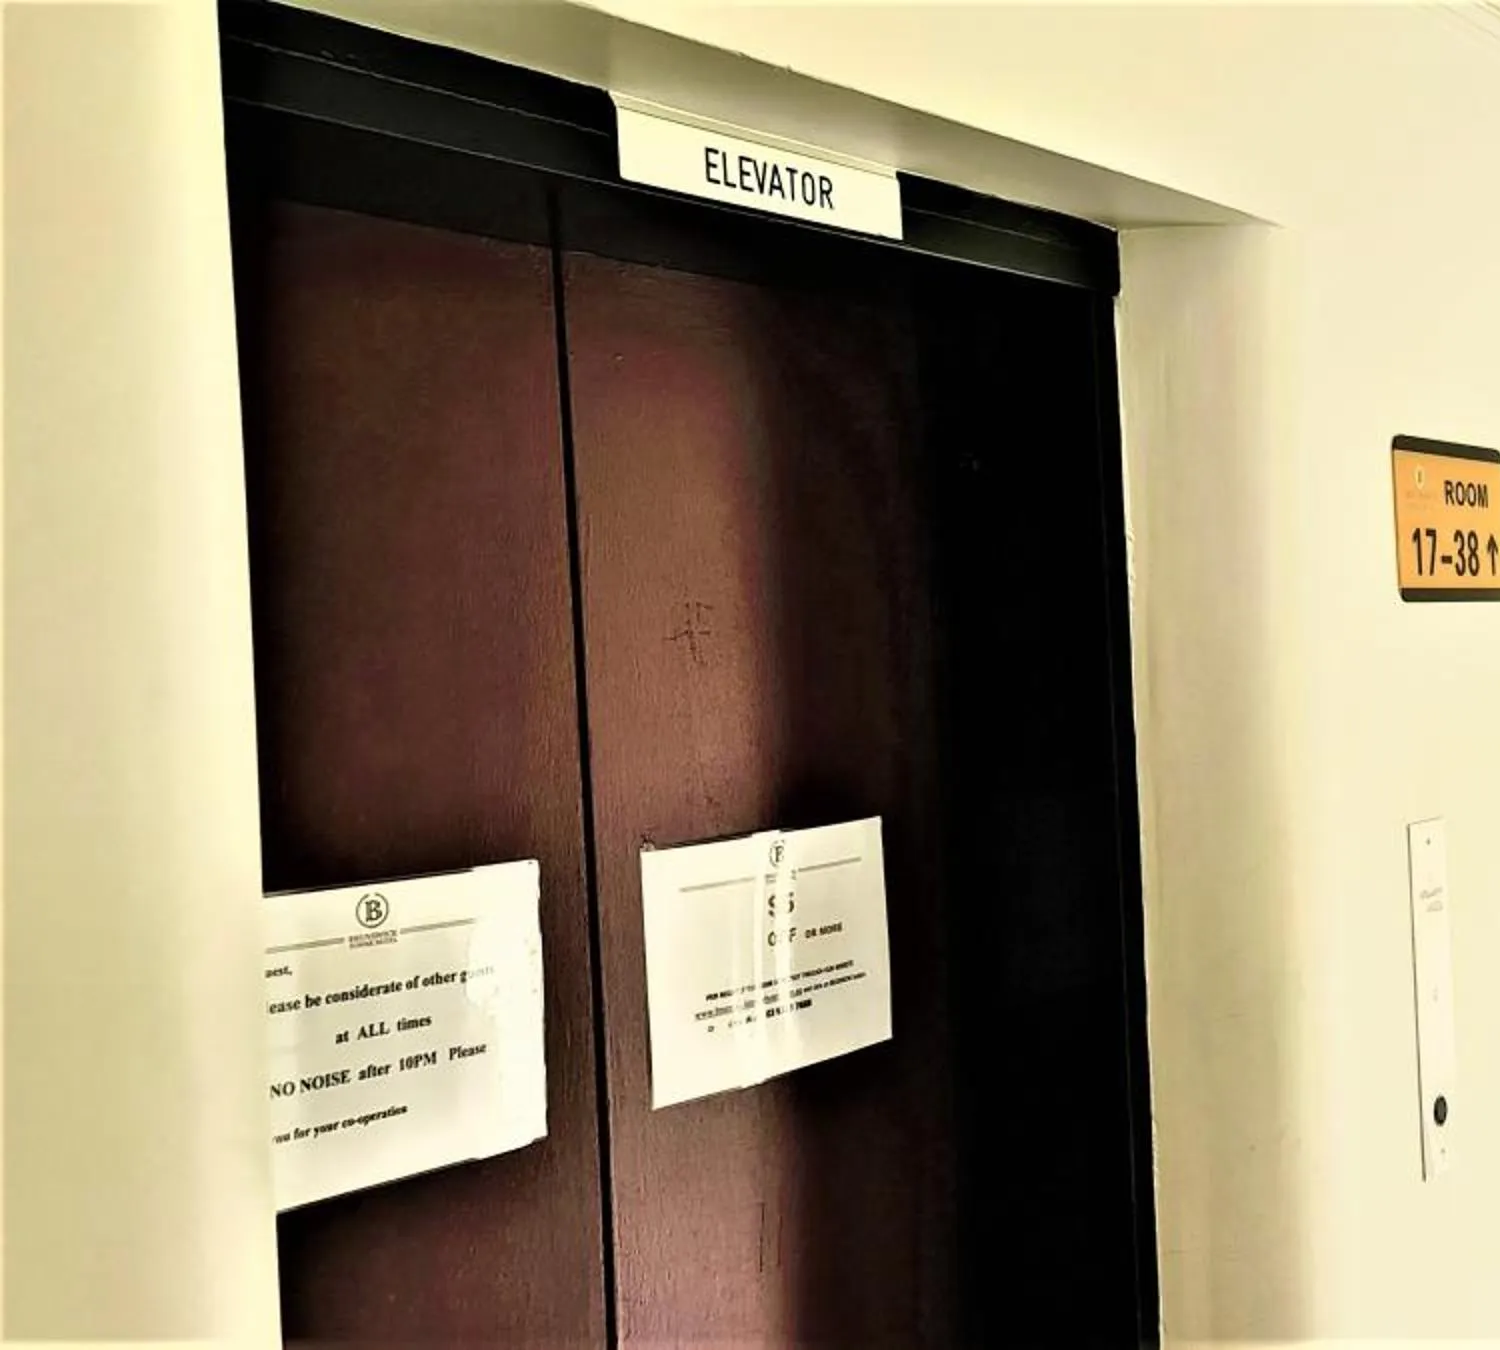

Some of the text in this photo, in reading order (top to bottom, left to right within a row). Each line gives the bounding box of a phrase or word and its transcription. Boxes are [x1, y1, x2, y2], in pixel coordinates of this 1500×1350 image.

[704, 146, 835, 210] ELEVATOR
[1443, 479, 1489, 509] ROOM
[1411, 527, 1481, 577] 17-38
[767, 926, 797, 947] OF
[267, 997, 301, 1015] ease
[304, 993, 322, 1008] be
[324, 980, 404, 1004] considerate
[405, 975, 421, 990] of
[421, 970, 458, 988] other
[334, 1014, 433, 1045] at ALL times
[269, 1041, 488, 1099] NO NOISE after 10PM Please
[293, 1126, 311, 1141] for
[313, 1120, 340, 1138] your
